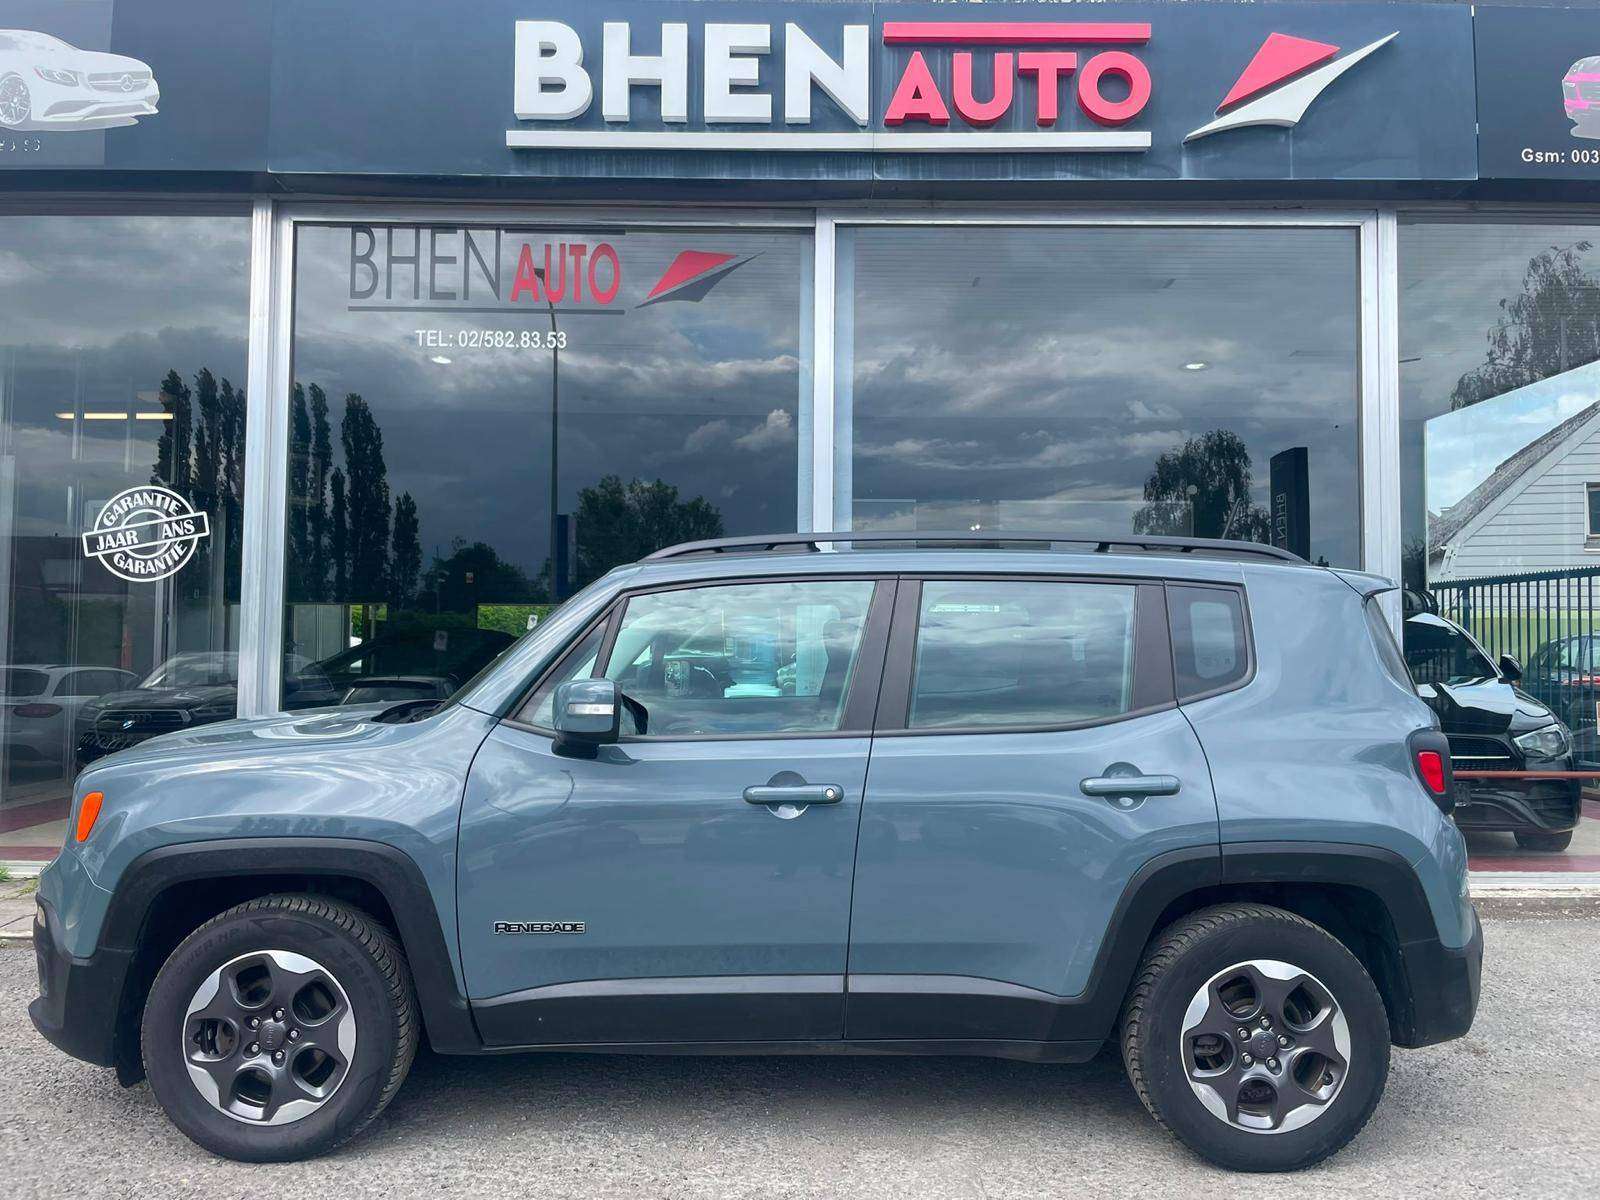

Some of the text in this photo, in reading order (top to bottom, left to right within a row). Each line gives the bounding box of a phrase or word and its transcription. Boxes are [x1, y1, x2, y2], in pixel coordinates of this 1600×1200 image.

[1521, 148, 1600, 163] Gsm: 003
[415, 330, 567, 349] TEL: 02/582.83.53
[103, 492, 182, 527] GARANTIE
[96, 519, 196, 551] JAAR ANS
[113, 543, 188, 575] GARANTIE
[494, 921, 586, 934] RENEGADE
